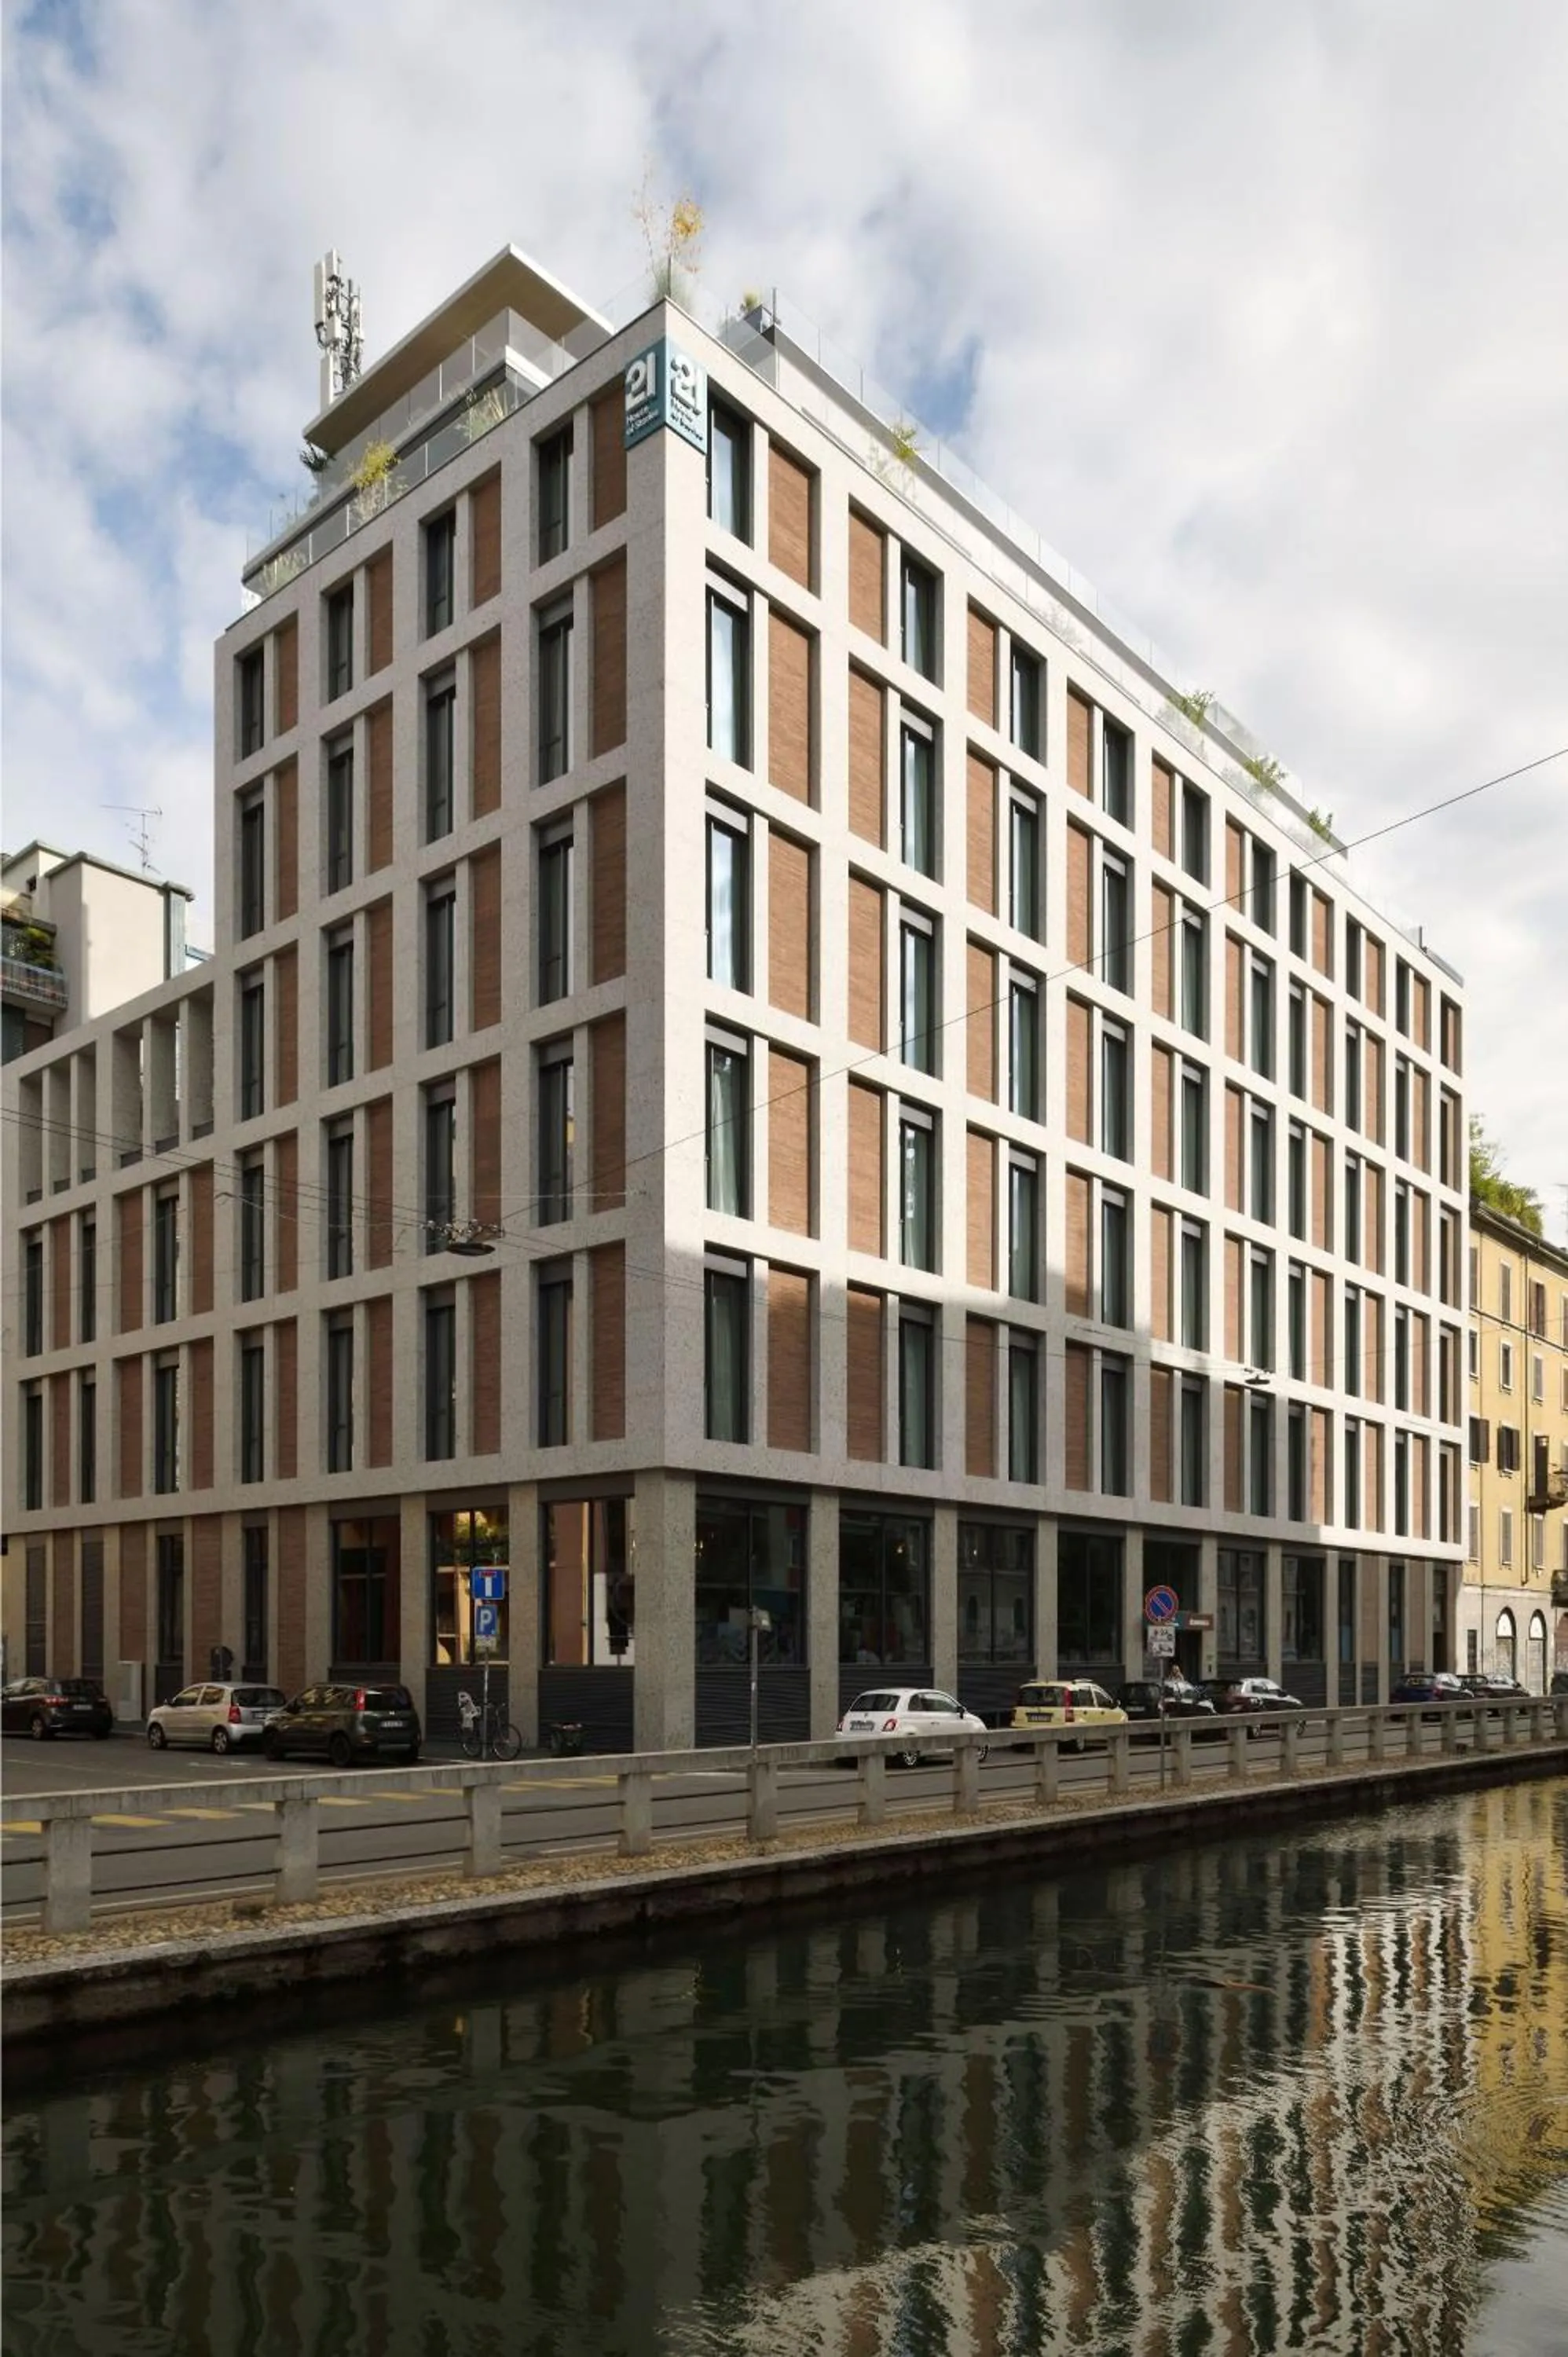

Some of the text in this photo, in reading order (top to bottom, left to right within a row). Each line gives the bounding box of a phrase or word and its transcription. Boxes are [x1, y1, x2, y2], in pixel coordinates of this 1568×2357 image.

[625, 352, 655, 410] 21
[671, 354, 702, 413] 21
[479, 1609, 492, 1632] P
